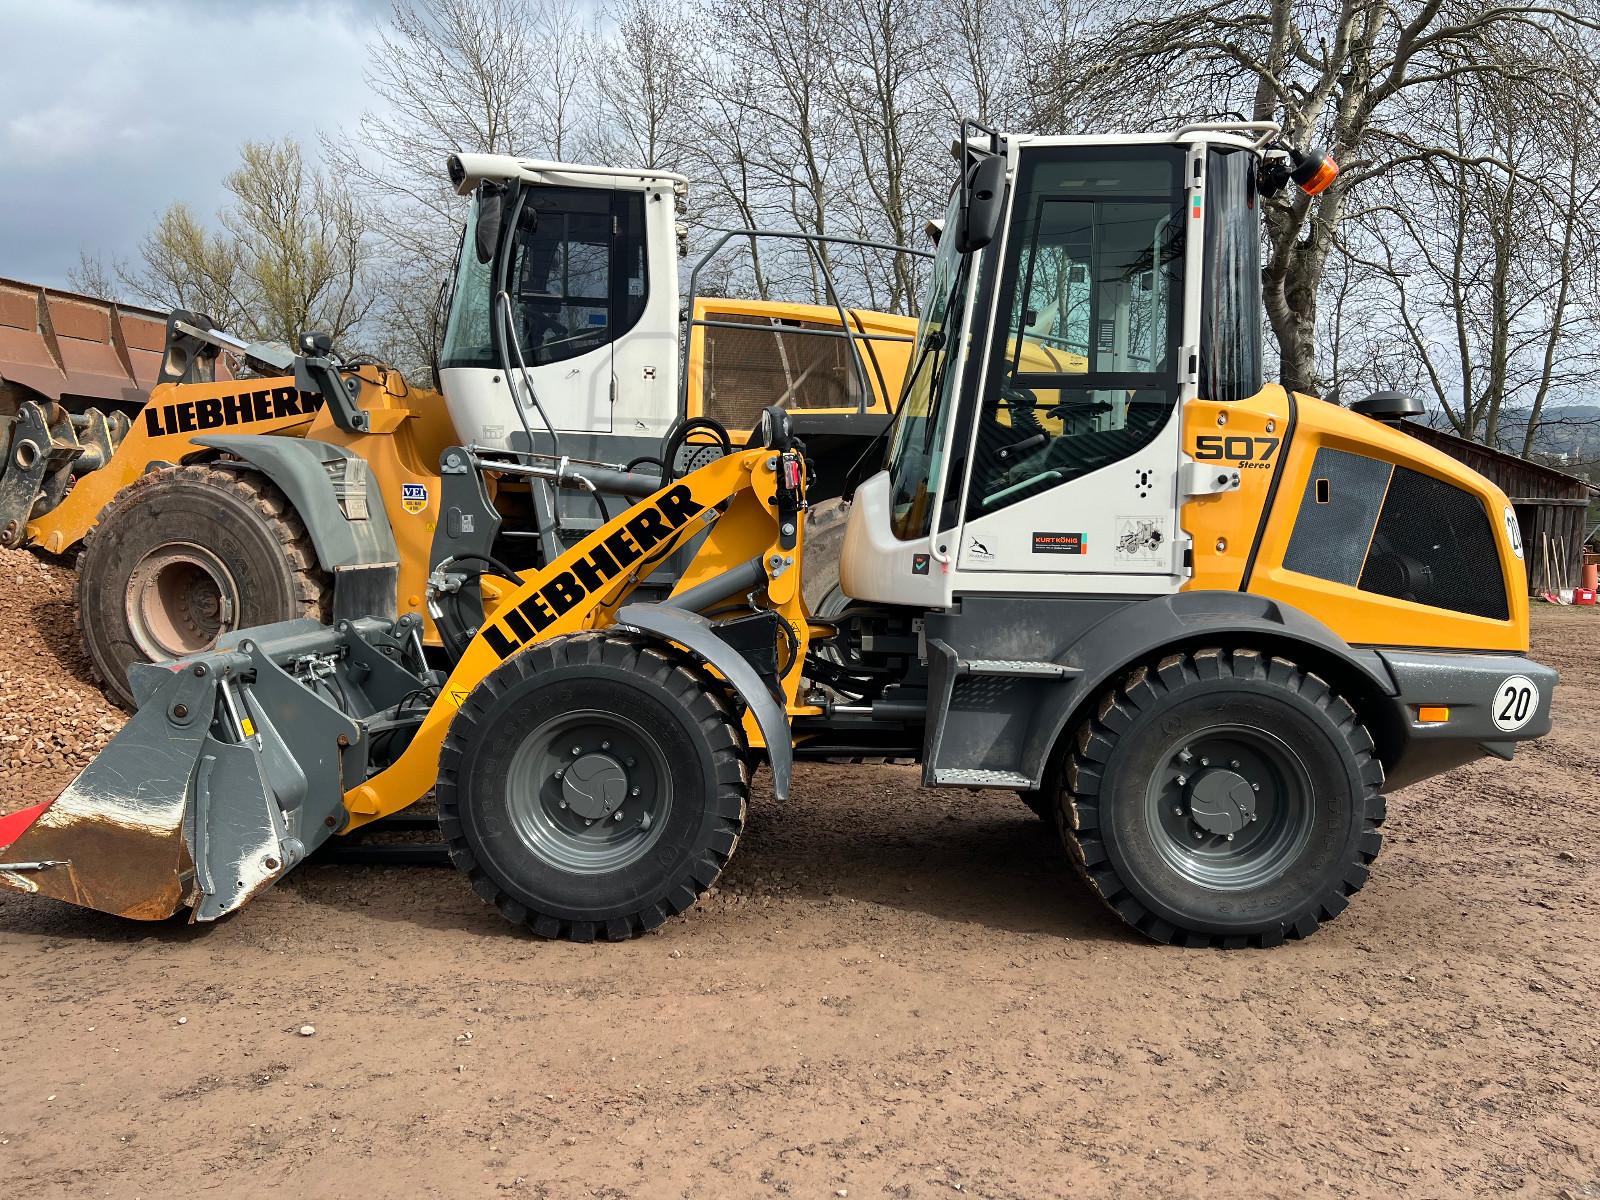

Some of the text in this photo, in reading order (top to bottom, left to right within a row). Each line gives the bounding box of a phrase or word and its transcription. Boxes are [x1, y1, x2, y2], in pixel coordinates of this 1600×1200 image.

[144, 386, 324, 438] LIEBHERR
[1195, 435, 1280, 460] 507
[1238, 460, 1271, 469] Stereo
[403, 487, 425, 497] VEI
[1055, 536, 1078, 544] KÖNIG
[481, 484, 706, 661] LIEBHERR
[1498, 686, 1531, 721] 20
